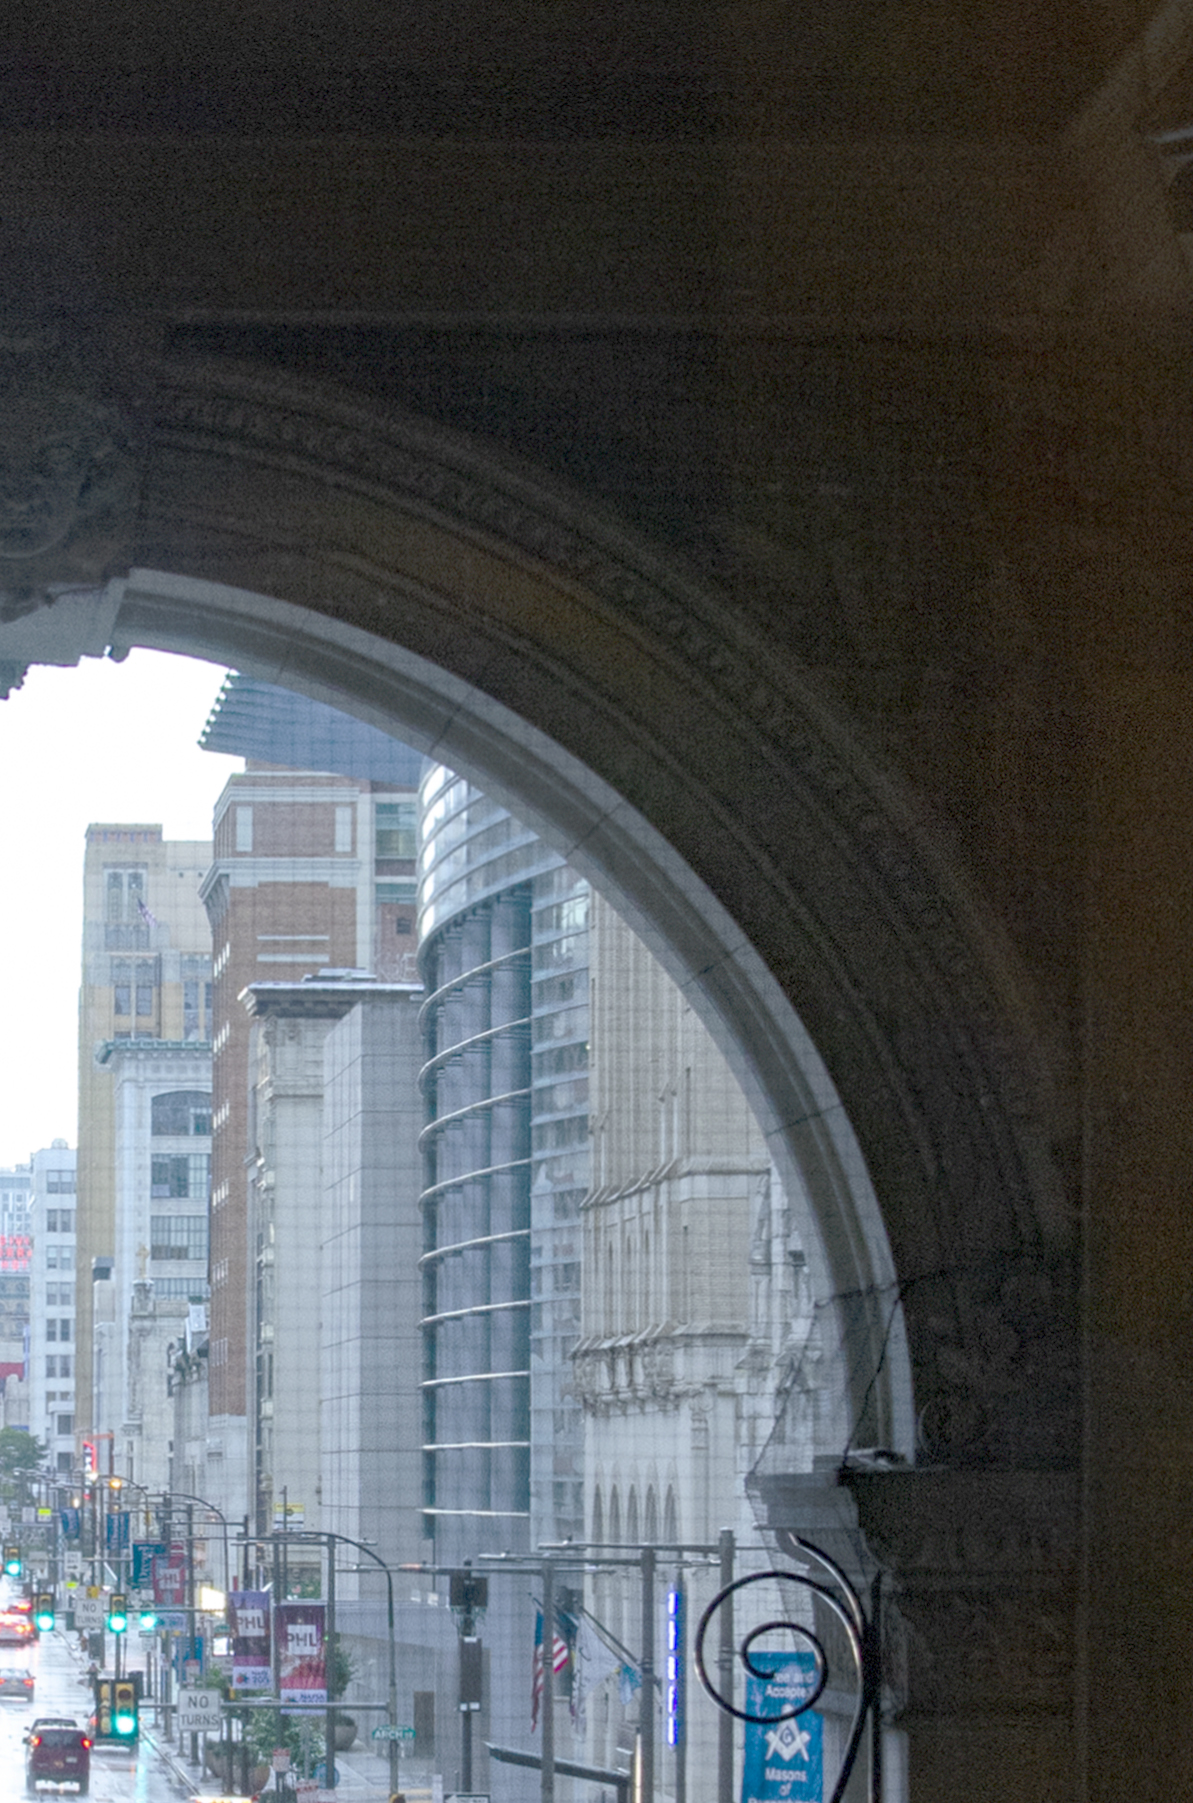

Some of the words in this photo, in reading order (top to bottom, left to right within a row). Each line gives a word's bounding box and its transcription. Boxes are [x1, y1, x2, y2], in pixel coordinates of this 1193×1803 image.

[82, 1603, 97, 1612] NO
[237, 1617, 265, 1630] PHL
[287, 1633, 318, 1647] PHL
[187, 1695, 209, 1709] NO
[180, 1714, 220, 1727] TURNS
[374, 1730, 403, 1739] ARCH
[764, 1767, 807, 1781] Masons
[778, 1783, 791, 1797] of
